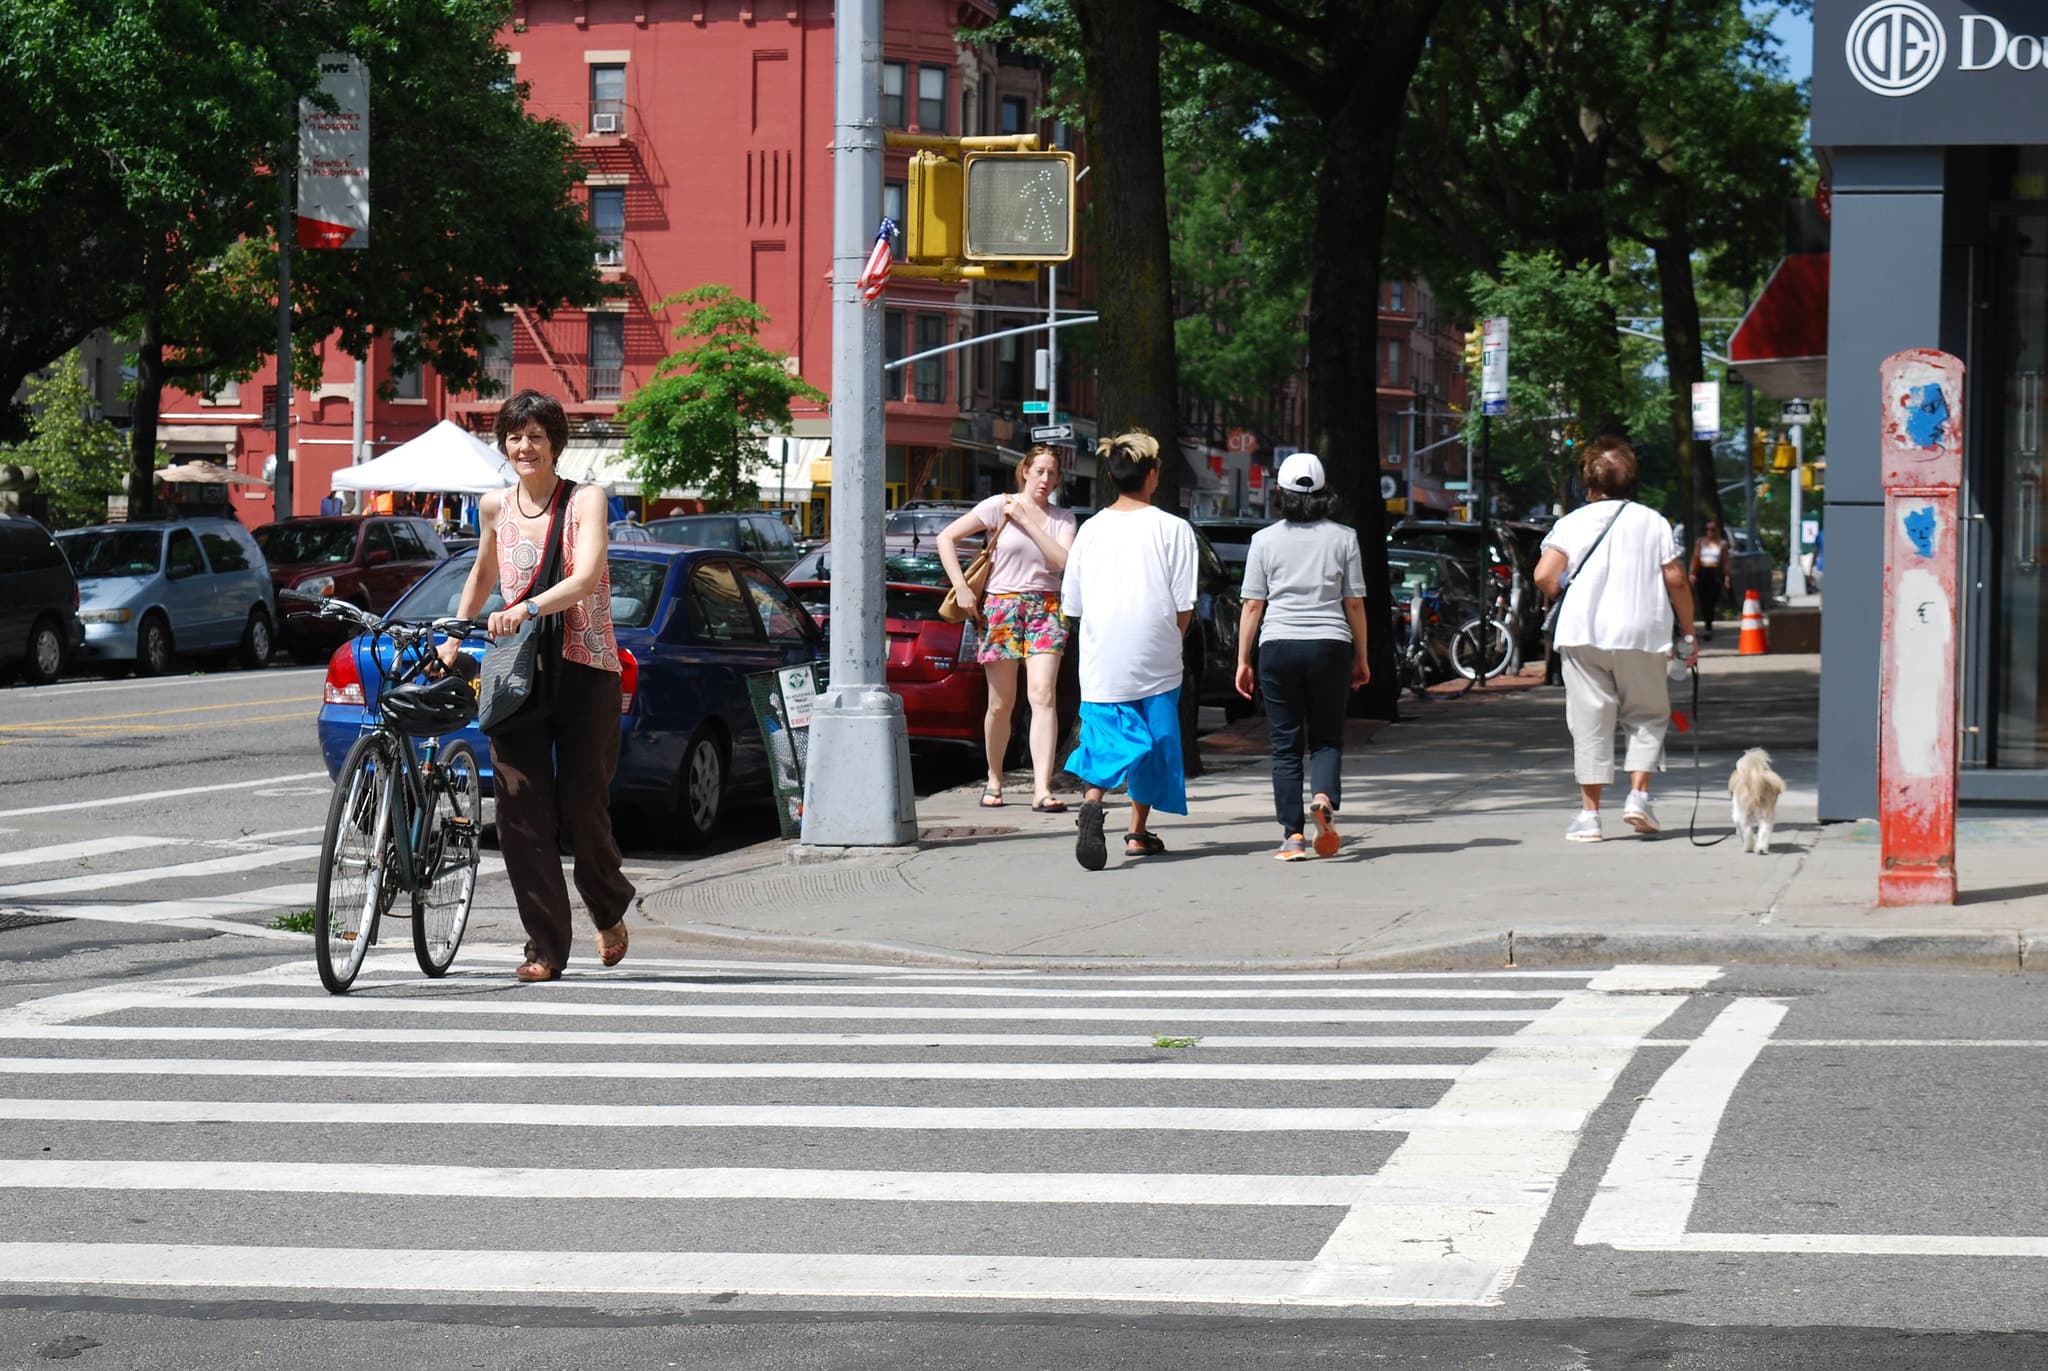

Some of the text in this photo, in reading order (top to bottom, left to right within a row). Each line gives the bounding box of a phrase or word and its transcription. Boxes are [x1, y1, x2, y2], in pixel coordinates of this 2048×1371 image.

[321, 63, 349, 73] NYC
[318, 122, 361, 131] HOSPITAL
[312, 168, 365, 179] Presbyterian
